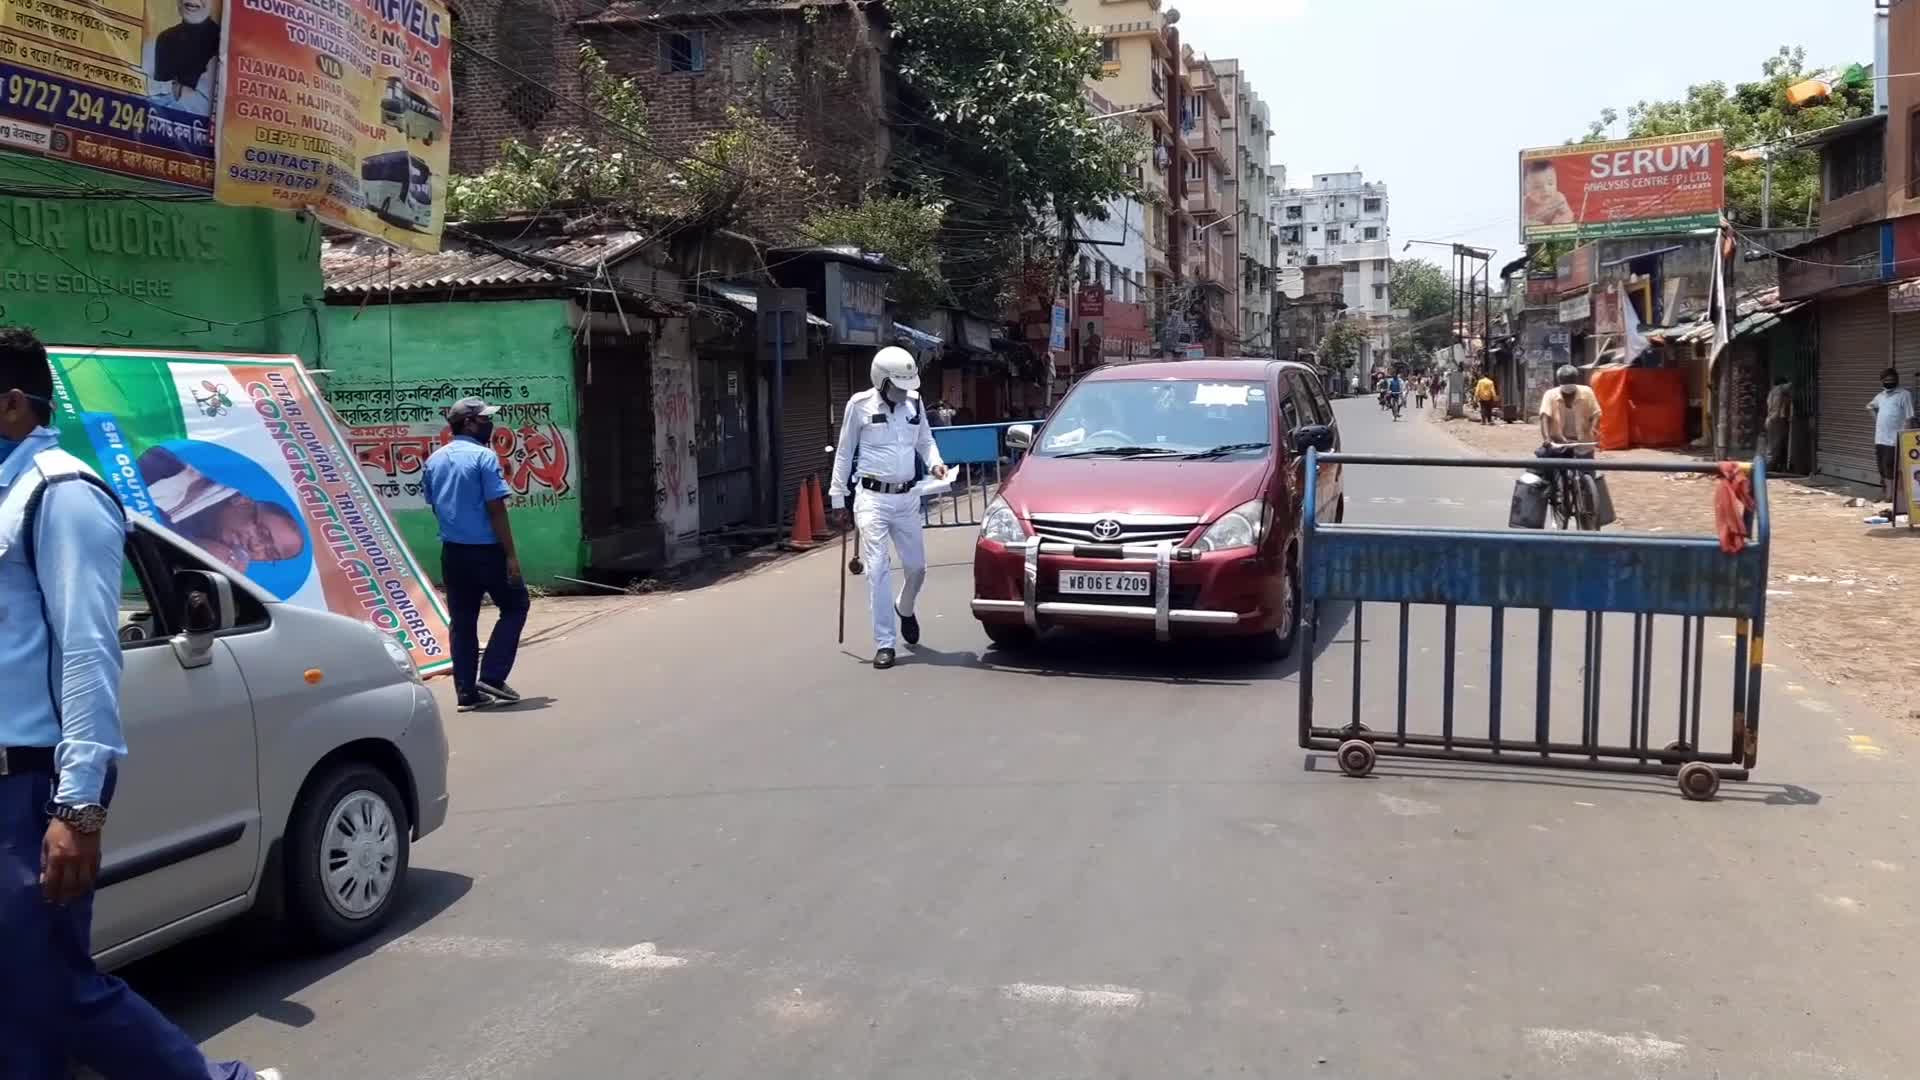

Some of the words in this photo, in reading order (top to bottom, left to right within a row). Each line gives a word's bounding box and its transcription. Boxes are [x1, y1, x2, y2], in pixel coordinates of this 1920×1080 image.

[245, 0, 315, 27] HOWRAH
[318, 17, 344, 39] FIRE
[287, 24, 306, 44] TO
[319, 58, 341, 78] VIA
[414, 48, 431, 69] AC
[239, 56, 310, 87] NAWADA,
[8, 74, 62, 114] 9727
[66, 88, 104, 125] 294
[109, 100, 145, 134] 294
[239, 80, 292, 105] PATNA,
[237, 103, 296, 128] GAROL,
[256, 127, 300, 148] DEPT
[1590, 142, 1711, 178] SERUM
[1583, 180, 1630, 192] ANALYSIS
[1631, 175, 1670, 188] CENTRE
[0, 199, 67, 250] OR
[84, 202, 218, 263] WORKS
[120, 277, 174, 299] HERE
[101, 421, 124, 449] SRI
[267, 372, 303, 418] UTTAR
[293, 420, 341, 484] HOWRAH
[335, 491, 393, 577] TRINAMOOL
[384, 577, 442, 656] CONGRESS
[1069, 575, 1085, 590] WB
[1087, 576, 1103, 590] 06
[1105, 576, 1113, 590] E
[1116, 577, 1148, 591] 4209
